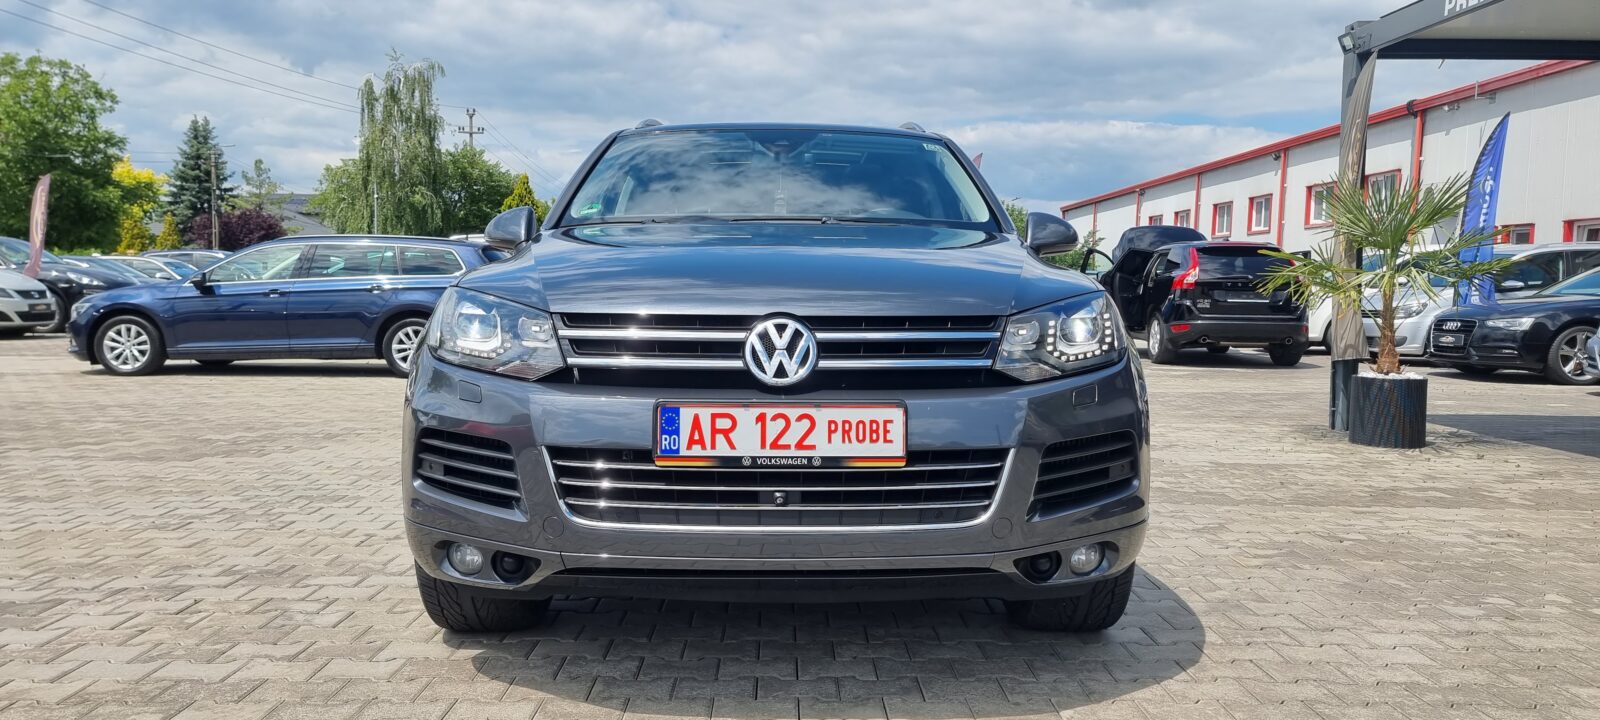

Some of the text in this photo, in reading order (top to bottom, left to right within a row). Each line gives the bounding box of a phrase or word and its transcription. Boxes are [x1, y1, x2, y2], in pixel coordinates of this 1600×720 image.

[685, 412, 894, 450] AR 122 PROBE
[661, 434, 679, 450] RO
[756, 457, 808, 465] VOLKSWAGEN
